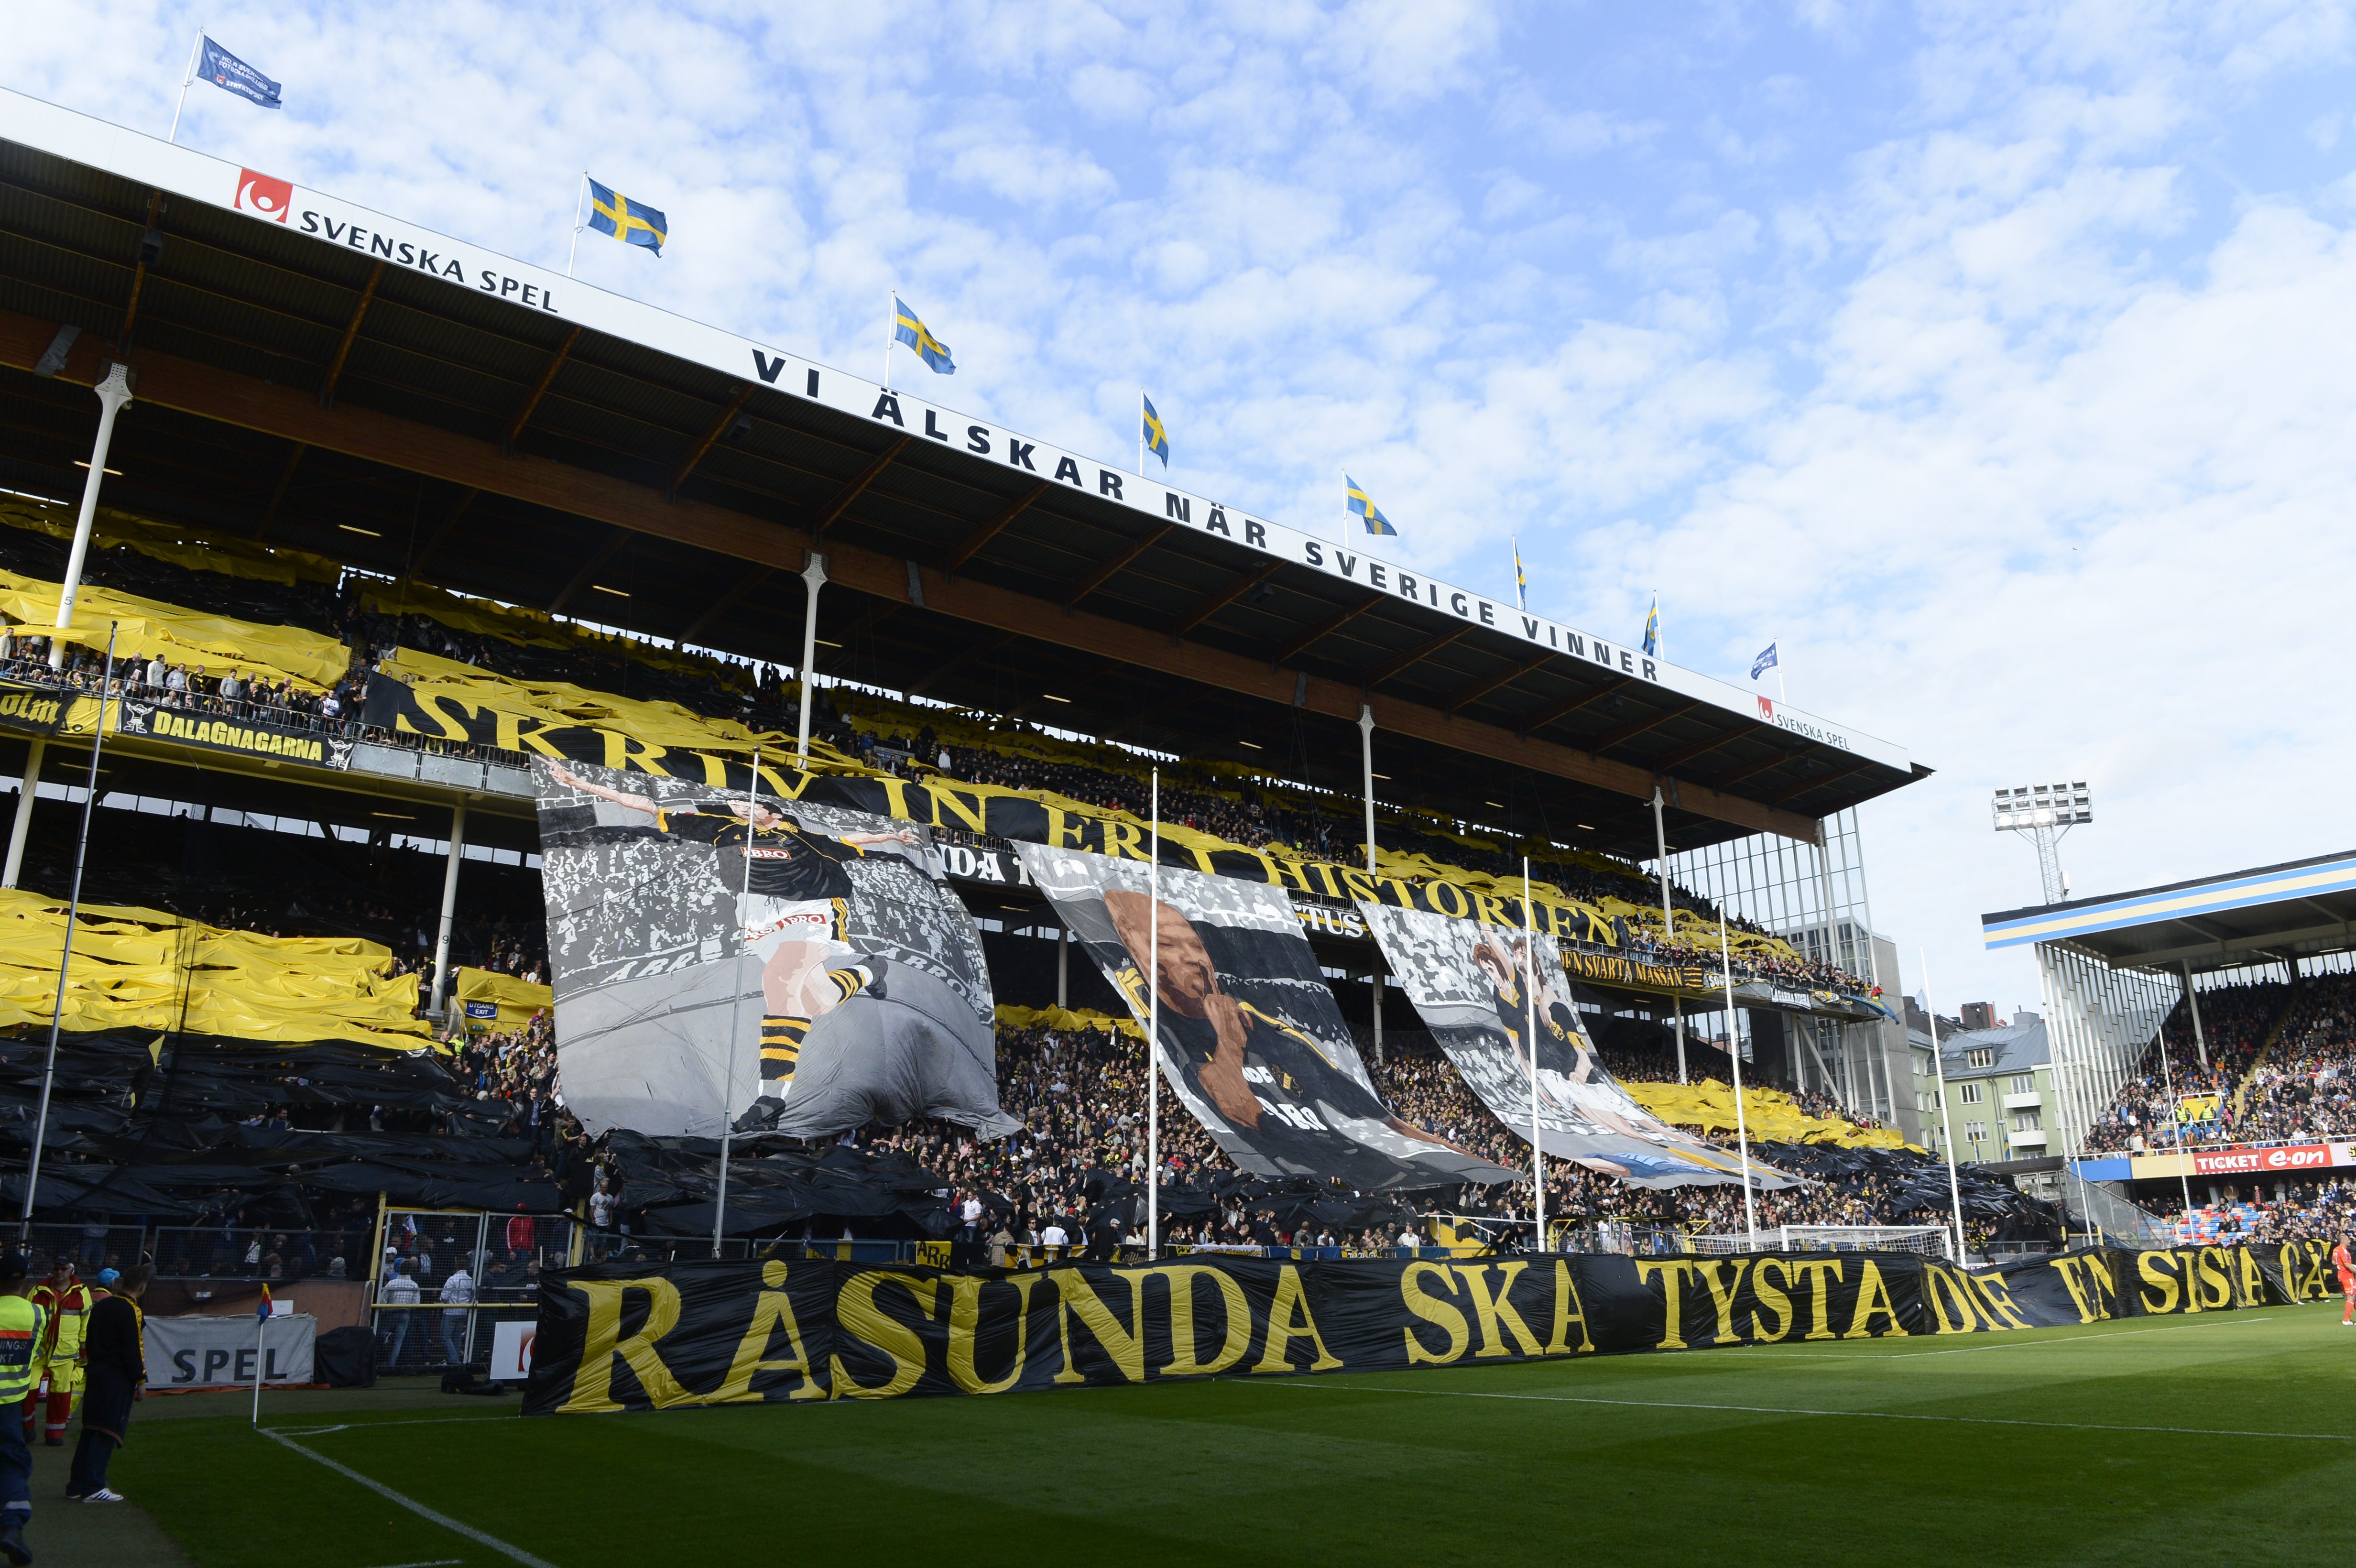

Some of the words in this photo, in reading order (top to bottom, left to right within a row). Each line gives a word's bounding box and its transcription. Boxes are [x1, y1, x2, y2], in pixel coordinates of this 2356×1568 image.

[300, 210, 464, 283] SVENSKA
[480, 270, 558, 313] SPEL
[752, 348, 819, 399] VI
[872, 387, 1123, 501] ÄLSKAR
[1166, 491, 1266, 549] NÄR
[1306, 541, 1494, 626] SVERIGE
[1521, 616, 1658, 682] VINNER
[153, 710, 323, 762] DALAGNAGARNA
[1777, 714, 1824, 742] SVENSKA
[1826, 732, 1851, 750] SPEL
[874, 776, 997, 835] IN
[783, 915, 823, 927] ABRO
[442, 935, 449, 944] 9
[1584, 955, 1633, 983] SVARTA
[1635, 961, 1682, 987] MASSAN
[2197, 1154, 2259, 1170] TICKET
[555, 1259, 1344, 1414] RÅSUNDA
[1401, 1259, 1595, 1364] SKA
[1635, 1258, 1909, 1349] TYSTA
[171, 1348, 288, 1383] SPEL
